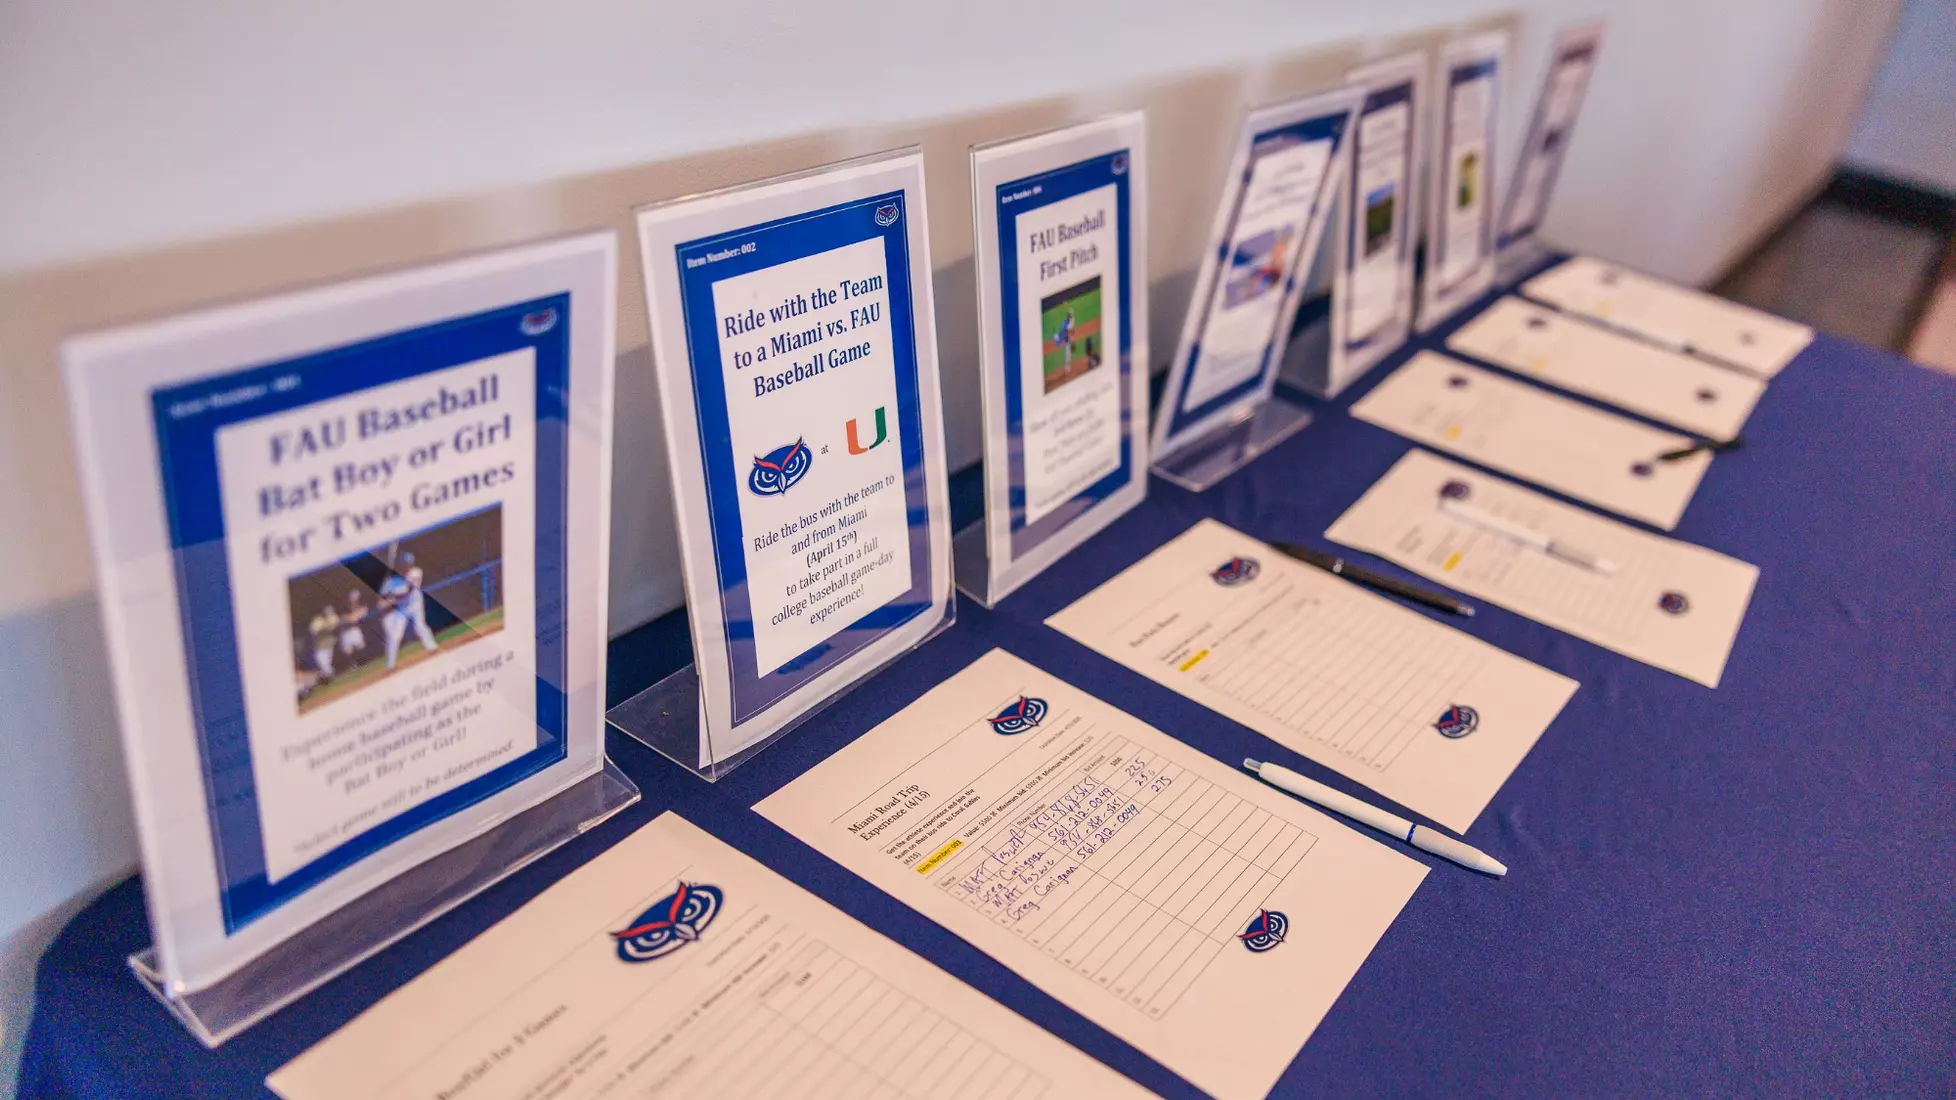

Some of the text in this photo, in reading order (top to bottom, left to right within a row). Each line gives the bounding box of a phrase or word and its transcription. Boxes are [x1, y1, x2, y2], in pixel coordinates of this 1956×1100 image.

[686, 241, 757, 270] Item Number: 002
[1030, 209, 1106, 254] FAU Baseball
[1040, 244, 1099, 282] First Pitch
[723, 274, 884, 339] Ride with the Team
[733, 302, 882, 370] to a Miami vs. FAU
[752, 341, 872, 398] Baseball Game
[269, 373, 499, 466] FAU Baseball
[820, 445, 829, 455] at
[257, 414, 512, 517] Bat Boy or Girl
[260, 461, 516, 565] for Two Games
[753, 475, 895, 552] Ride the bus with the team to
[791, 505, 868, 555] and from Miami
[785, 536, 879, 597] to take part in a full
[806, 541, 834, 568] (April
[771, 551, 895, 626] college baseball game-day
[810, 583, 865, 625] experience!
[281, 650, 515, 762] Experience the field during a
[358, 704, 428, 745] baseball
[431, 688, 472, 717] game
[475, 678, 497, 696] by
[325, 702, 483, 786] participating as the
[343, 727, 468, 796] Bat Boy or Girl!
[442, 738, 516, 782] determined
[847, 783, 920, 835] Miami Road Trip
[860, 790, 931, 841] Experience (4/15)
[996, 795, 1019, 812] Minimum
[1042, 760, 1062, 776] Minimum
[1048, 787, 1114, 841] 561-212-0049
[1125, 756, 1145, 777] 225
[894, 848, 910, 860] team
[927, 828, 938, 837] bus
[937, 820, 948, 830] ride
[951, 805, 965, 818] Coral
[963, 795, 981, 809] Gables
[896, 840, 906, 848] the
[906, 829, 924, 841] athlete
[922, 808, 947, 829] experience
[947, 802, 958, 810] and
[965, 788, 975, 797] the
[1006, 901, 1040, 921] Greg
[1077, 804, 1140, 859] 561-212-0049
[1151, 776, 1172, 792] 275
